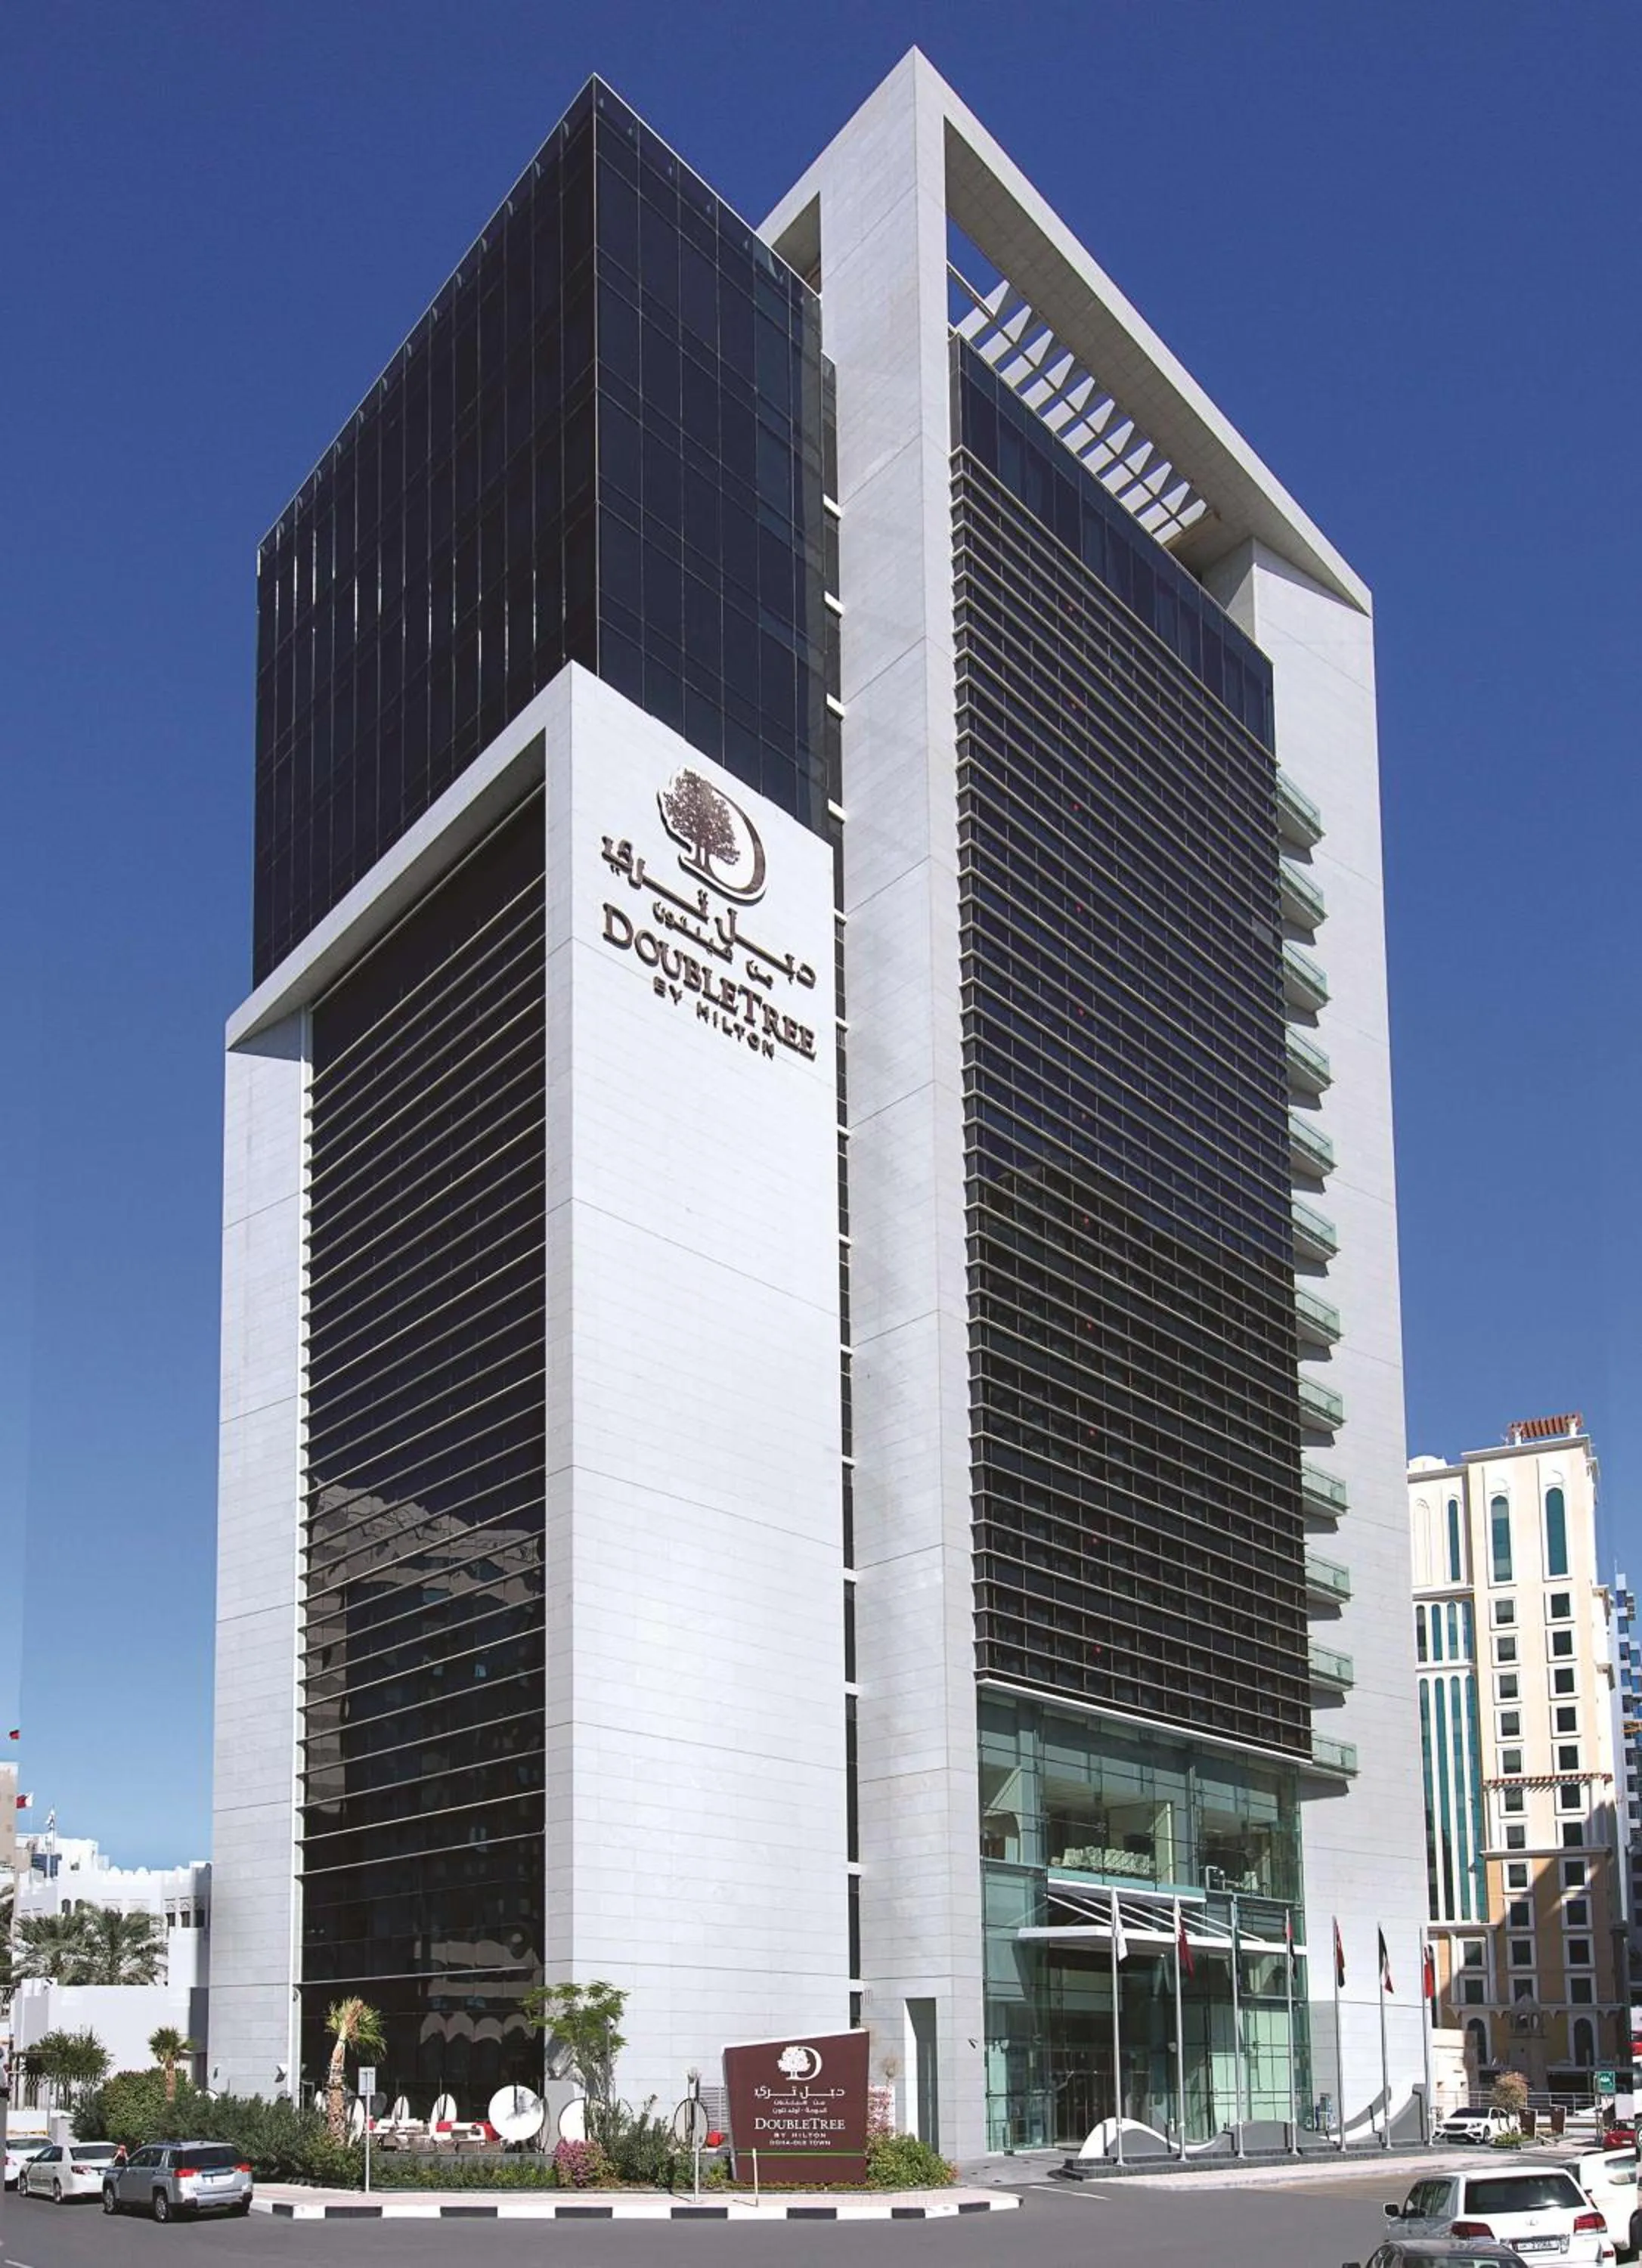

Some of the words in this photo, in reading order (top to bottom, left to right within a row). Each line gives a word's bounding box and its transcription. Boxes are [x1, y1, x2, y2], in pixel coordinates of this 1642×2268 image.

[603, 903, 816, 1061] DOUBLETREE
[653, 976, 683, 1005] BY
[696, 1002, 776, 1060] HILTON
[754, 2118, 845, 2130] DOUBLETREE
